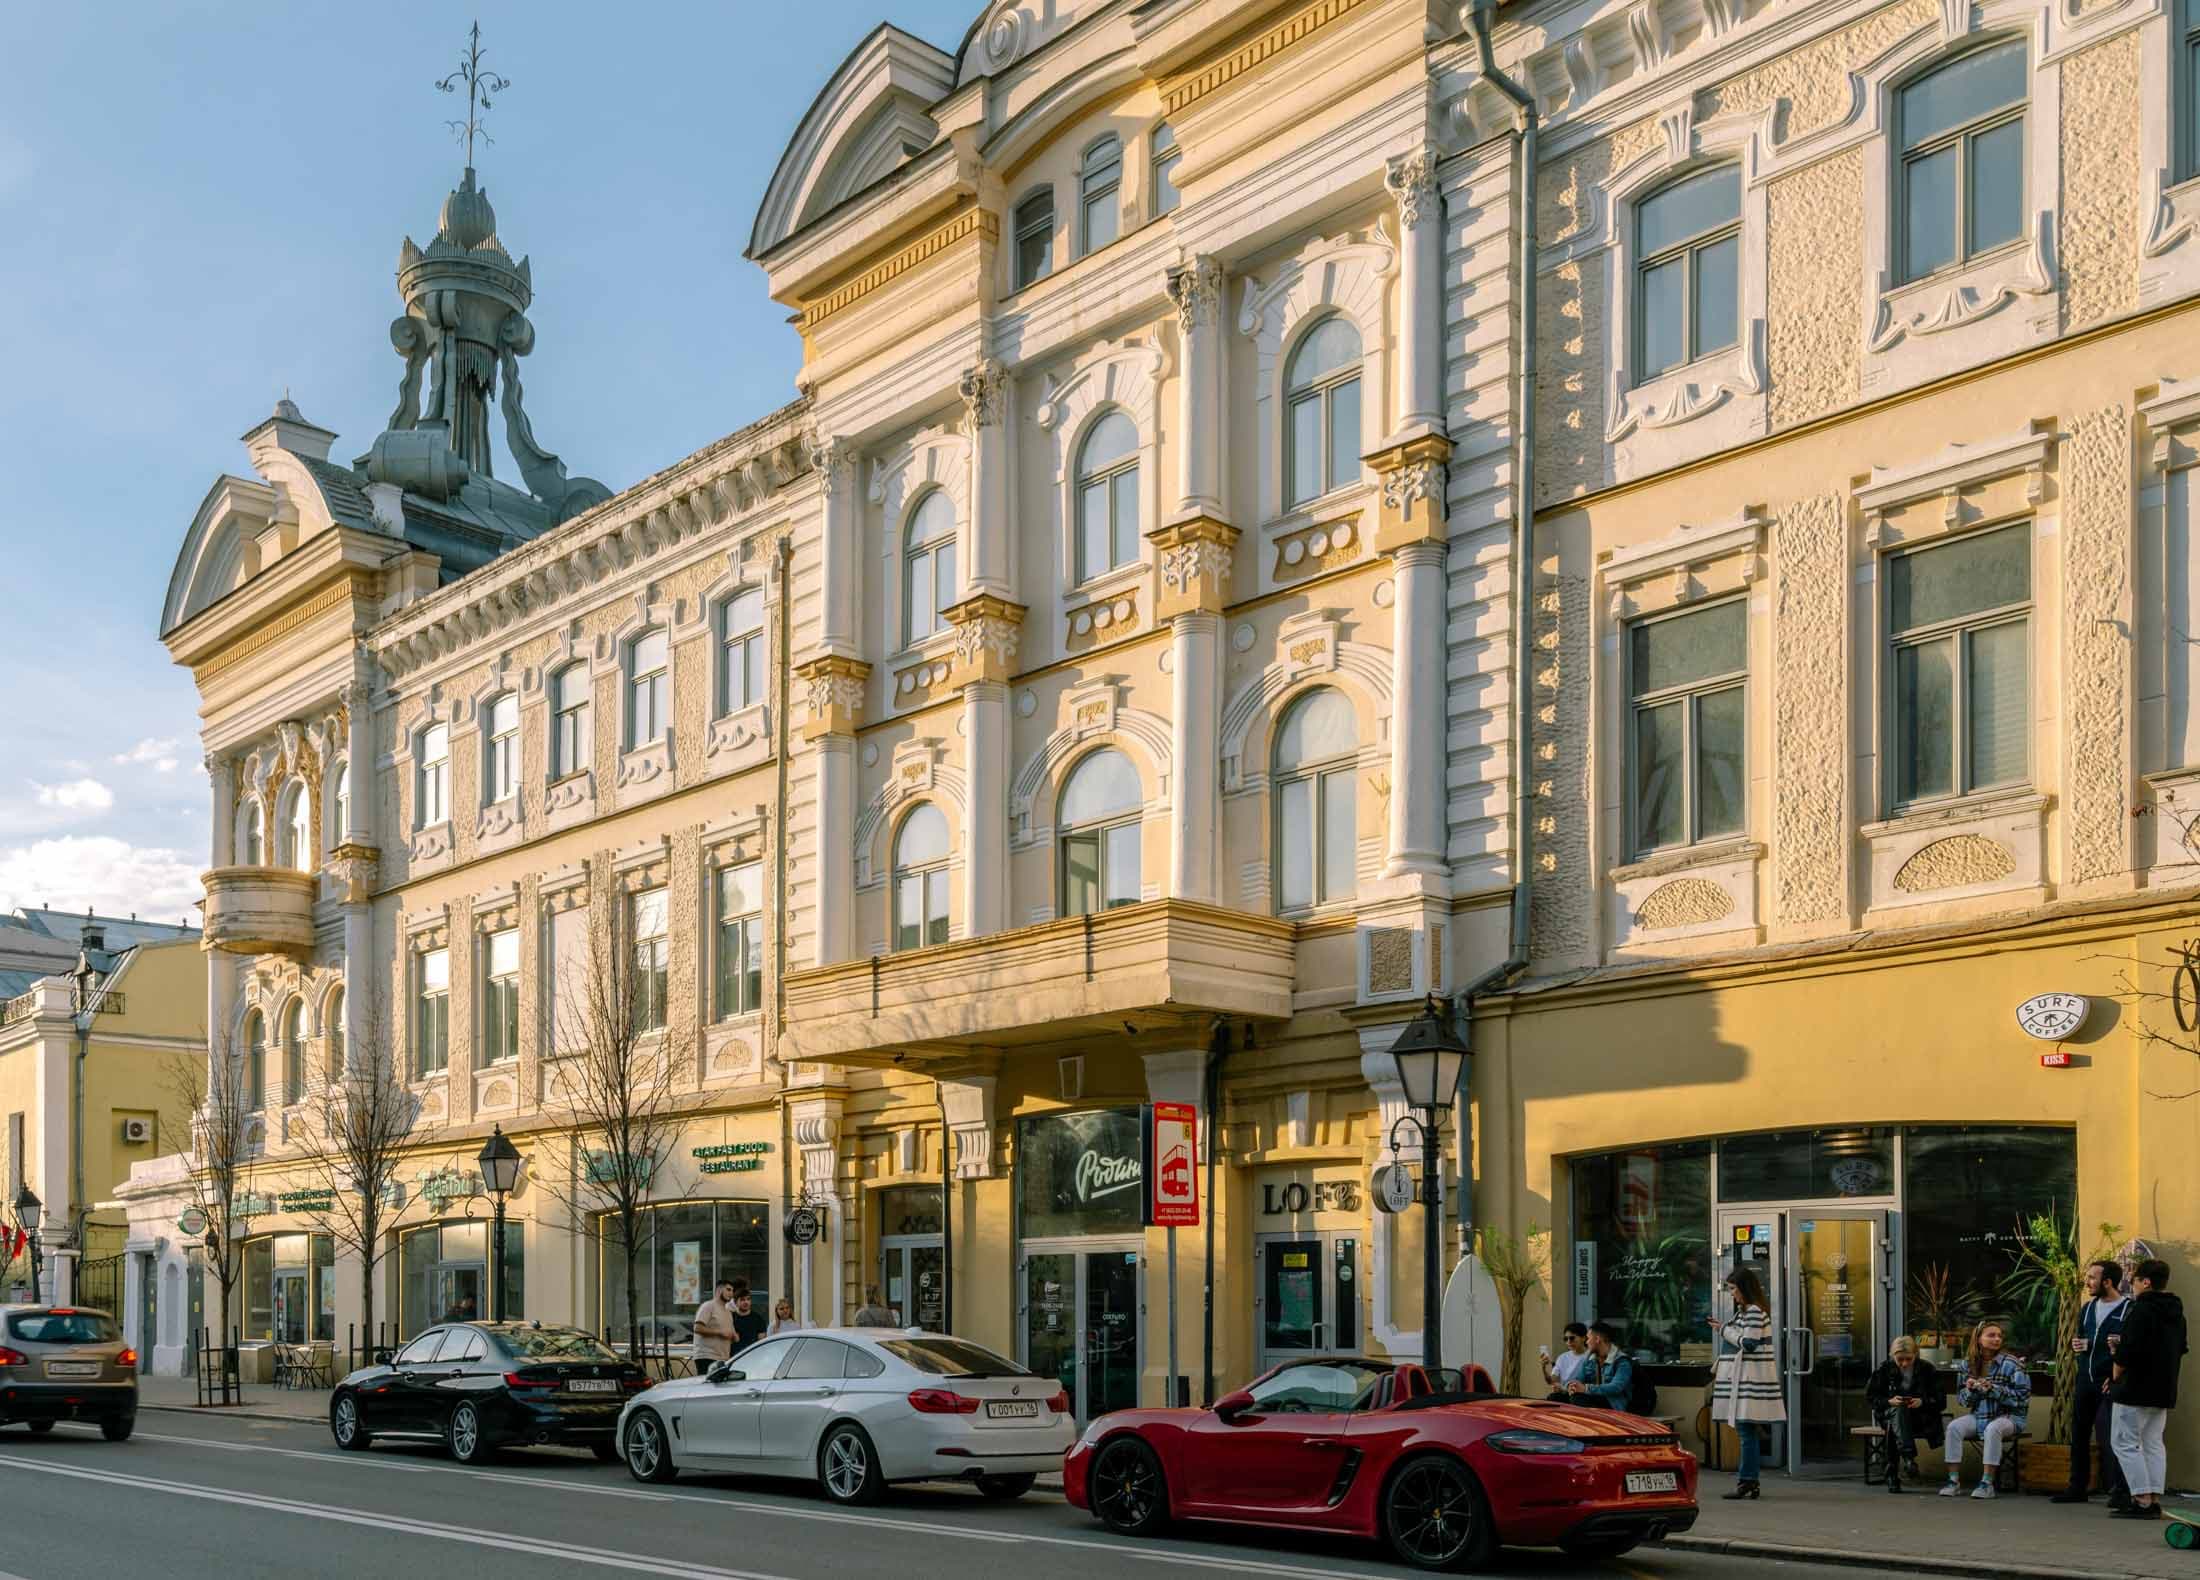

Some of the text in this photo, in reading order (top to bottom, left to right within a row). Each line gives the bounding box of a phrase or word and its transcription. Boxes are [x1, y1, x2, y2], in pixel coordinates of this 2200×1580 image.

[2024, 997, 2077, 1015] SURF
[2028, 1018, 2074, 1035] COFFEE
[2043, 1054, 2065, 1065] KISS
[717, 1145, 738, 1157] FAST
[739, 1142, 765, 1155] FOOD
[1390, 1196, 1409, 1206] LOFT
[1623, 1256, 1664, 1271] Happy
[1579, 1248, 1588, 1296] SURF COFFEE
